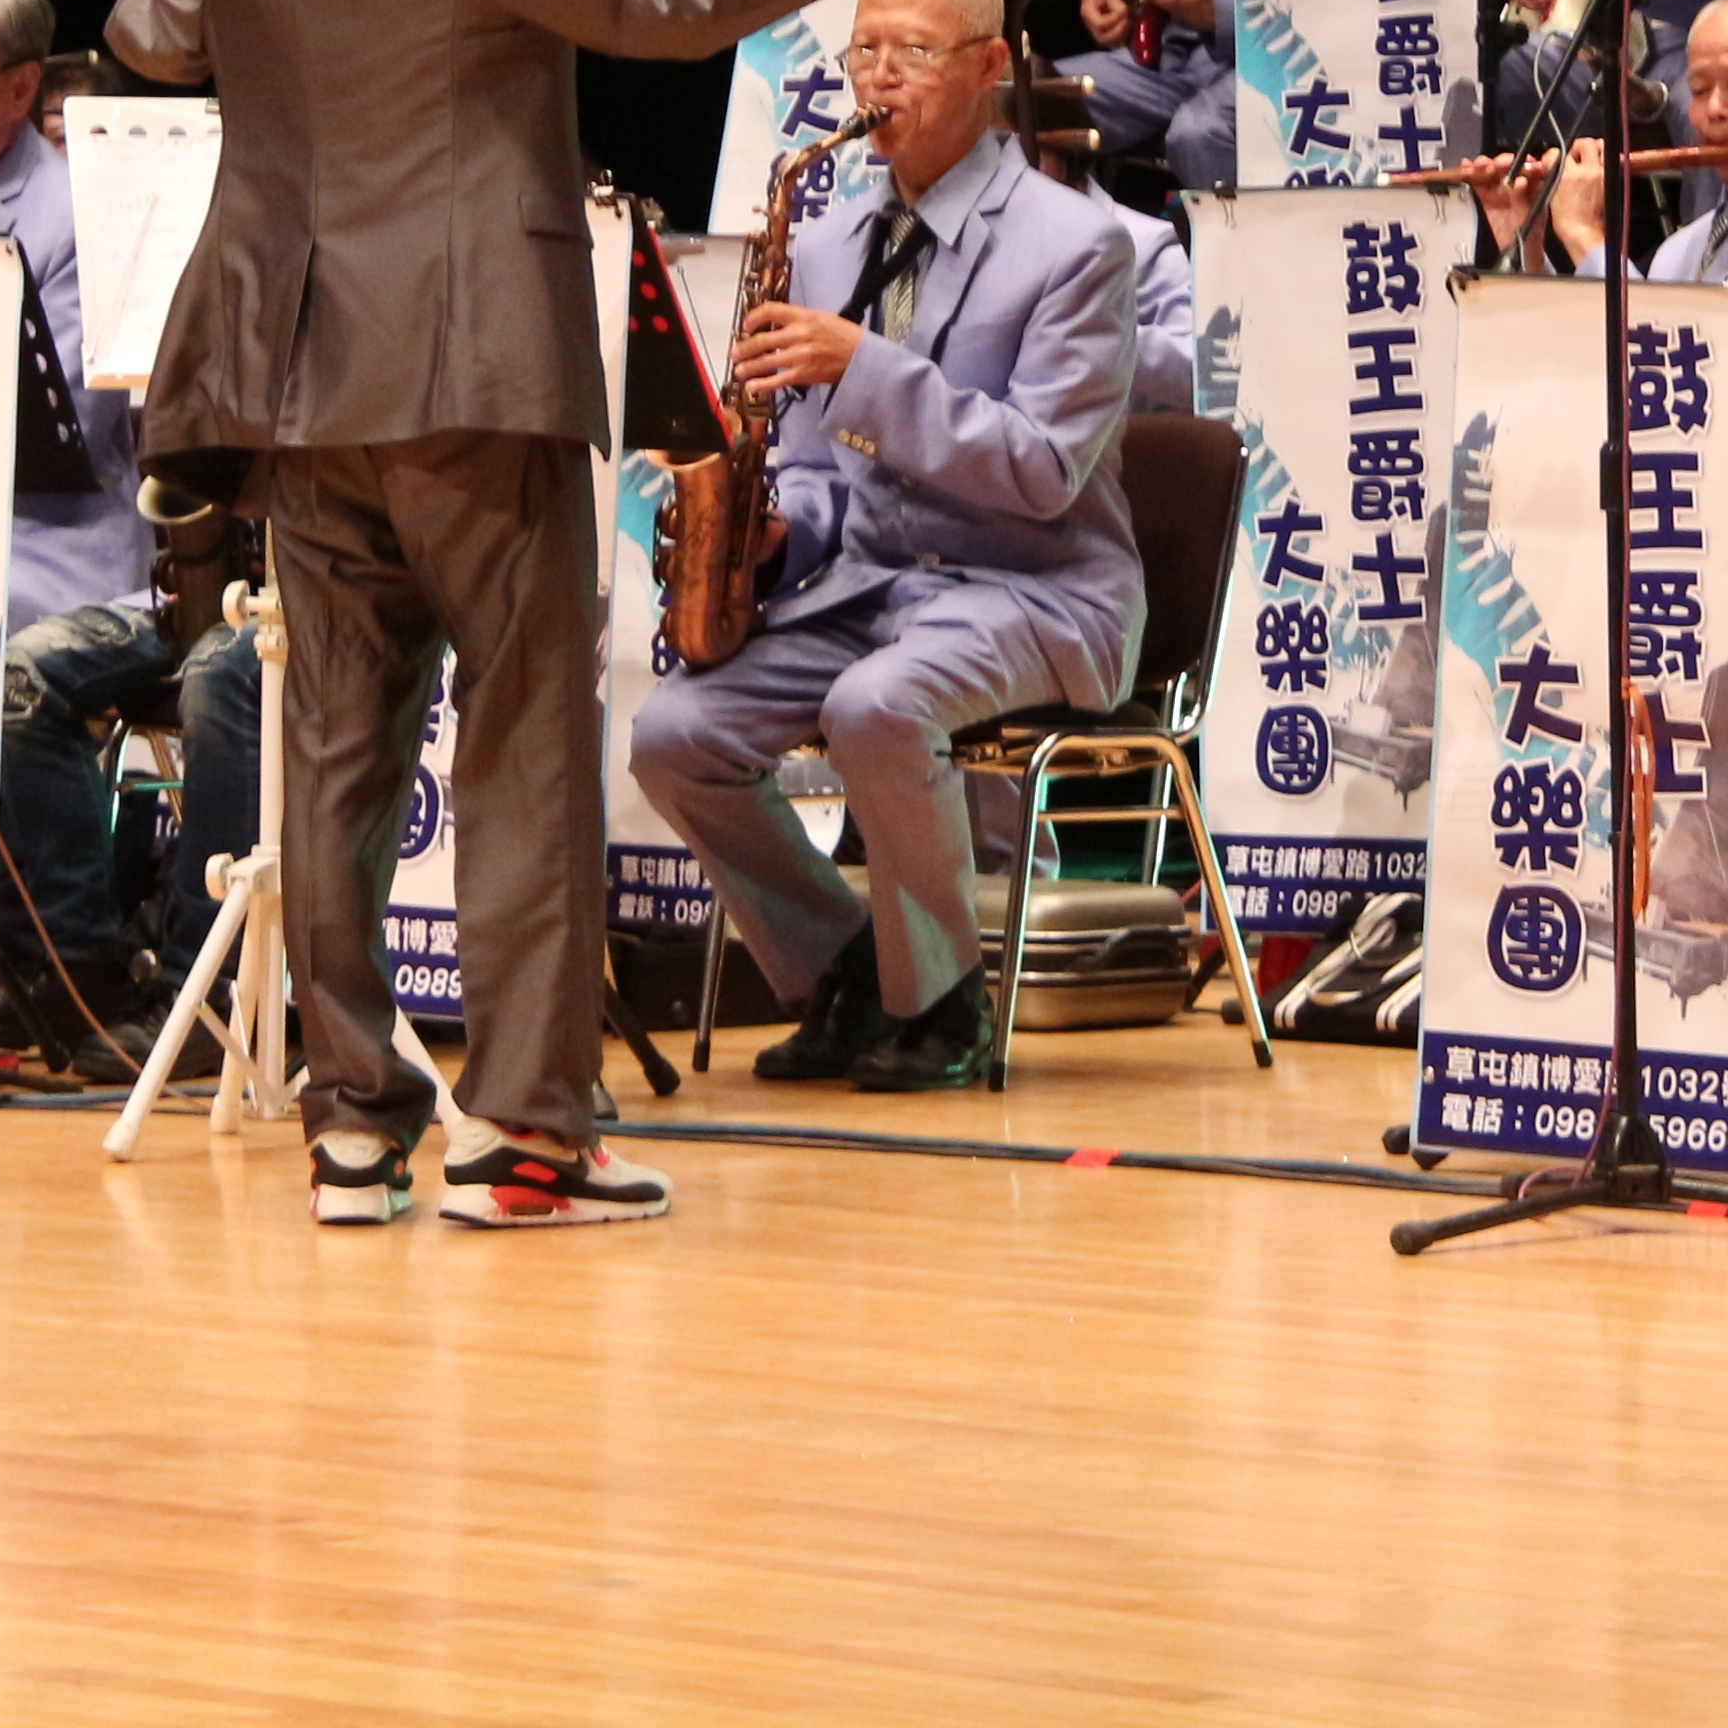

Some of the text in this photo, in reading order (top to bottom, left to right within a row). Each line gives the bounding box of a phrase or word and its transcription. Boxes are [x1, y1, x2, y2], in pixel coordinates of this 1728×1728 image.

[1343, 222, 1429, 622] 鼓王爵士
[1625, 321, 1712, 797] 鼓王爵士
[1256, 500, 1332, 797] 大樂團
[1489, 645, 1587, 992] 大樂團
